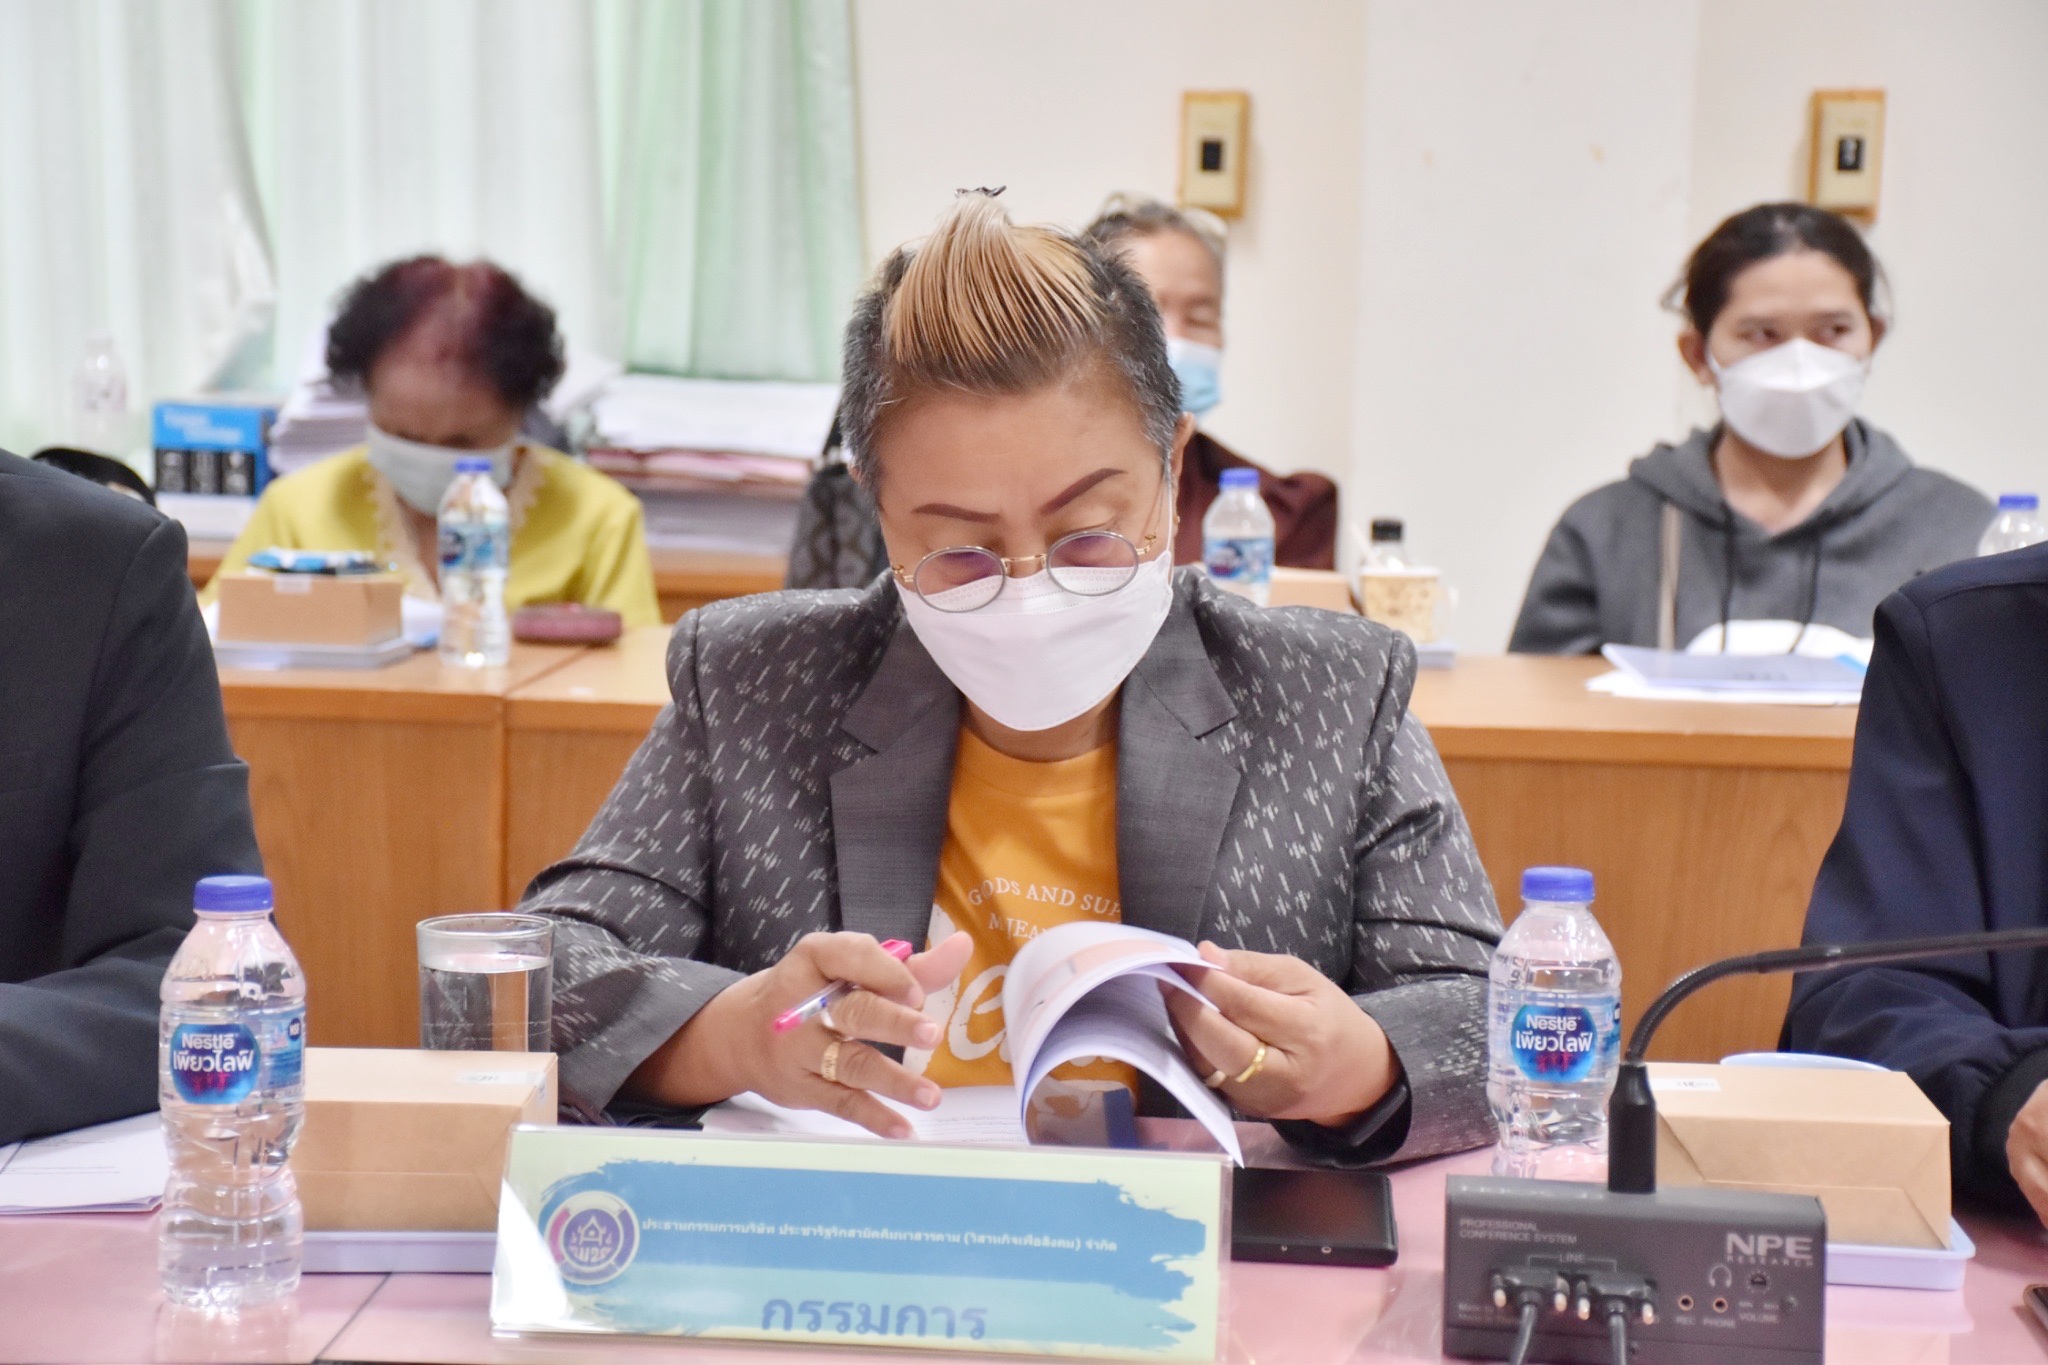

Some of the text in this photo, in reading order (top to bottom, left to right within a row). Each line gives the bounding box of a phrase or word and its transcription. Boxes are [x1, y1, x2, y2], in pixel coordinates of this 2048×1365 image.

[968, 877, 1021, 906] GODS
[1026, 883, 1076, 907] AND
[1007, 917, 1047, 940] JEA
[1460, 1218, 1538, 1231] PROFESSIONAL
[1460, 1229, 1577, 1244] CONFERENCE SYSTEM
[1726, 1232, 1813, 1260] NPE
[1726, 1254, 1814, 1269] RESEARCH
[761, 1298, 988, 1341] กรรมการ
